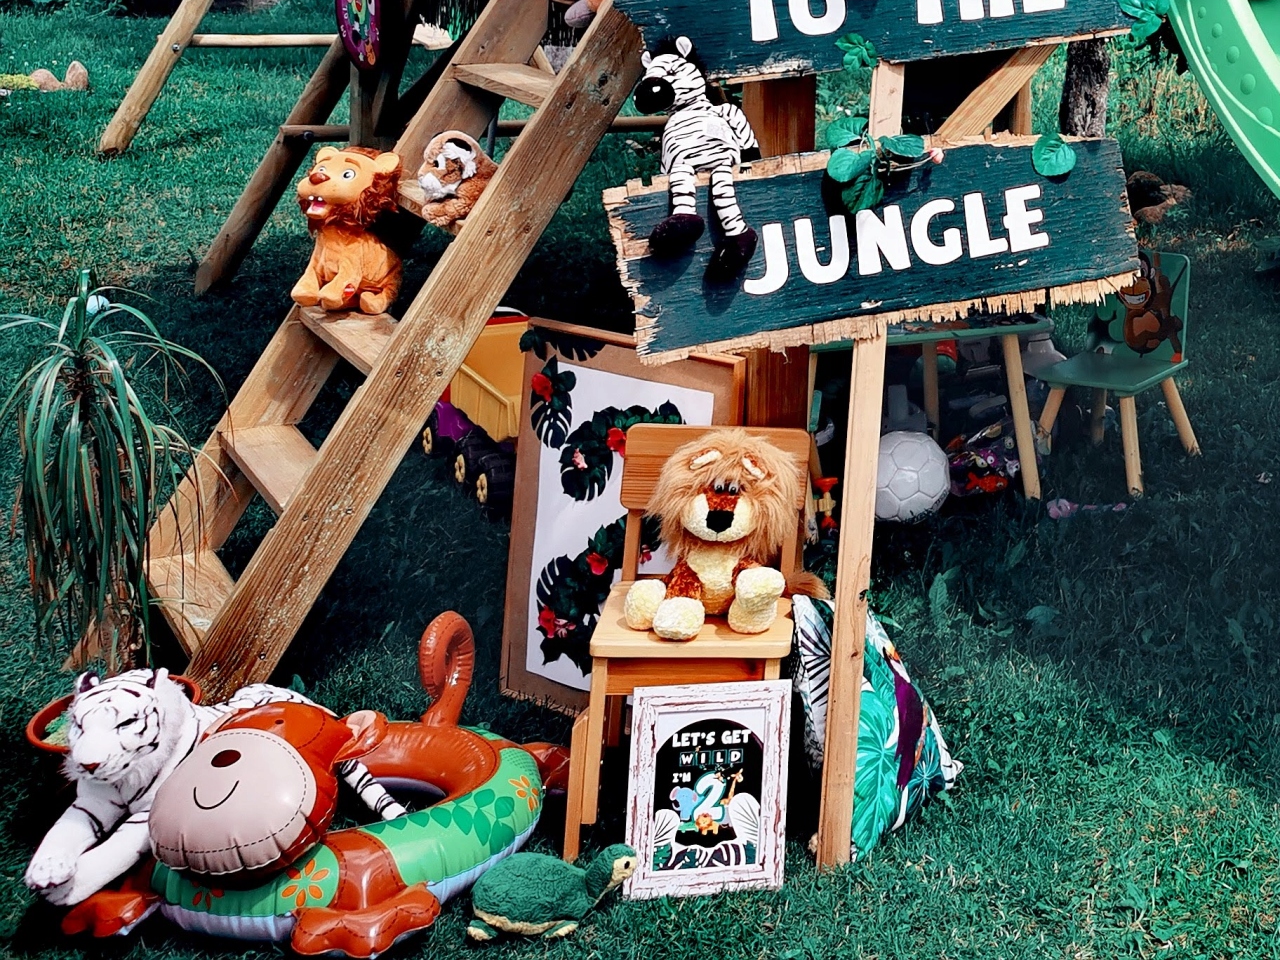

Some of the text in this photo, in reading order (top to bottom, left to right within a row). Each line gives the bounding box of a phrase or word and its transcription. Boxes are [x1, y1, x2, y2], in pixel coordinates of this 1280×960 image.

[743, 184, 1050, 296] JUNGLE
[672, 729, 752, 748] LET'S GET
[681, 751, 741, 765] WILD
[672, 771, 726, 821] I'M 2
